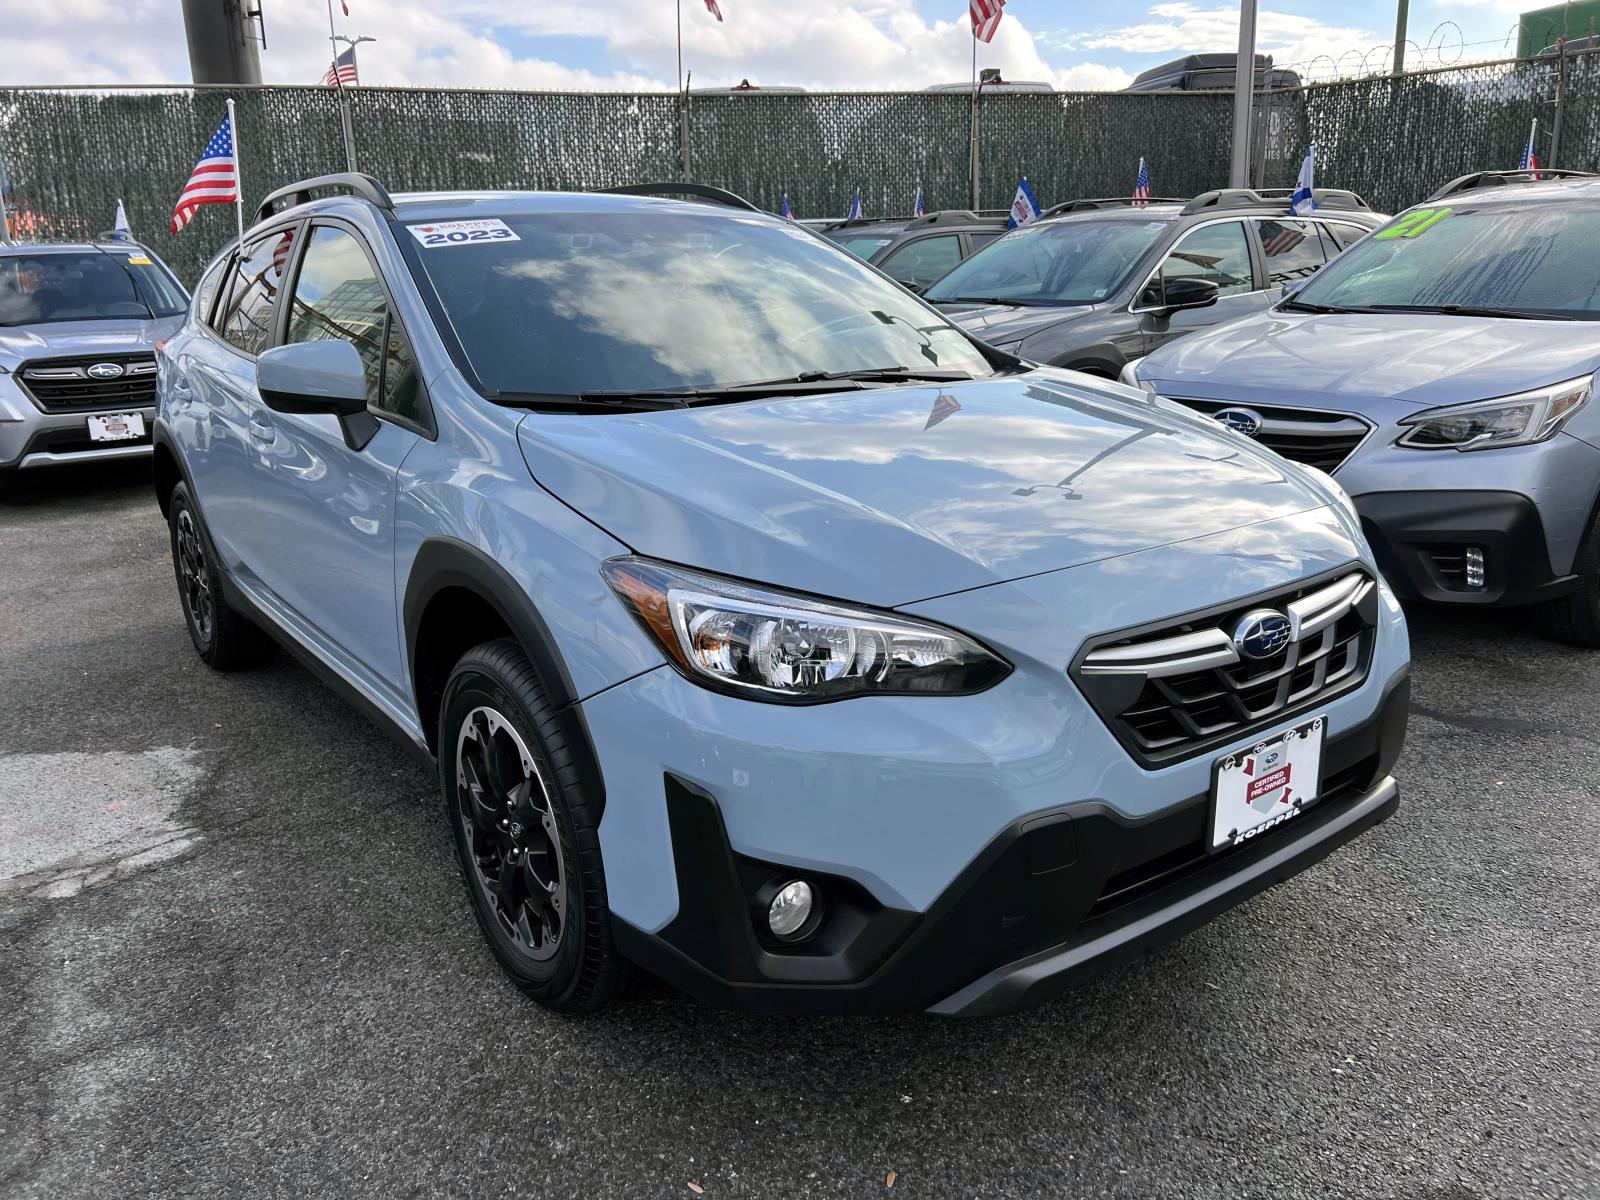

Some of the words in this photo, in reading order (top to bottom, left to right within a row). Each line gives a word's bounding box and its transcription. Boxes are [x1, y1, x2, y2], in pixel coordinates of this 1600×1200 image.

[439, 220, 499, 229] KOEPPEL
[1374, 207, 1453, 239] 21
[424, 229, 512, 245] 2023
[1251, 777, 1286, 797] PRE-OWNED
[1254, 770, 1284, 788] CERTIFIED
[1234, 807, 1301, 845] KOEPPEL
